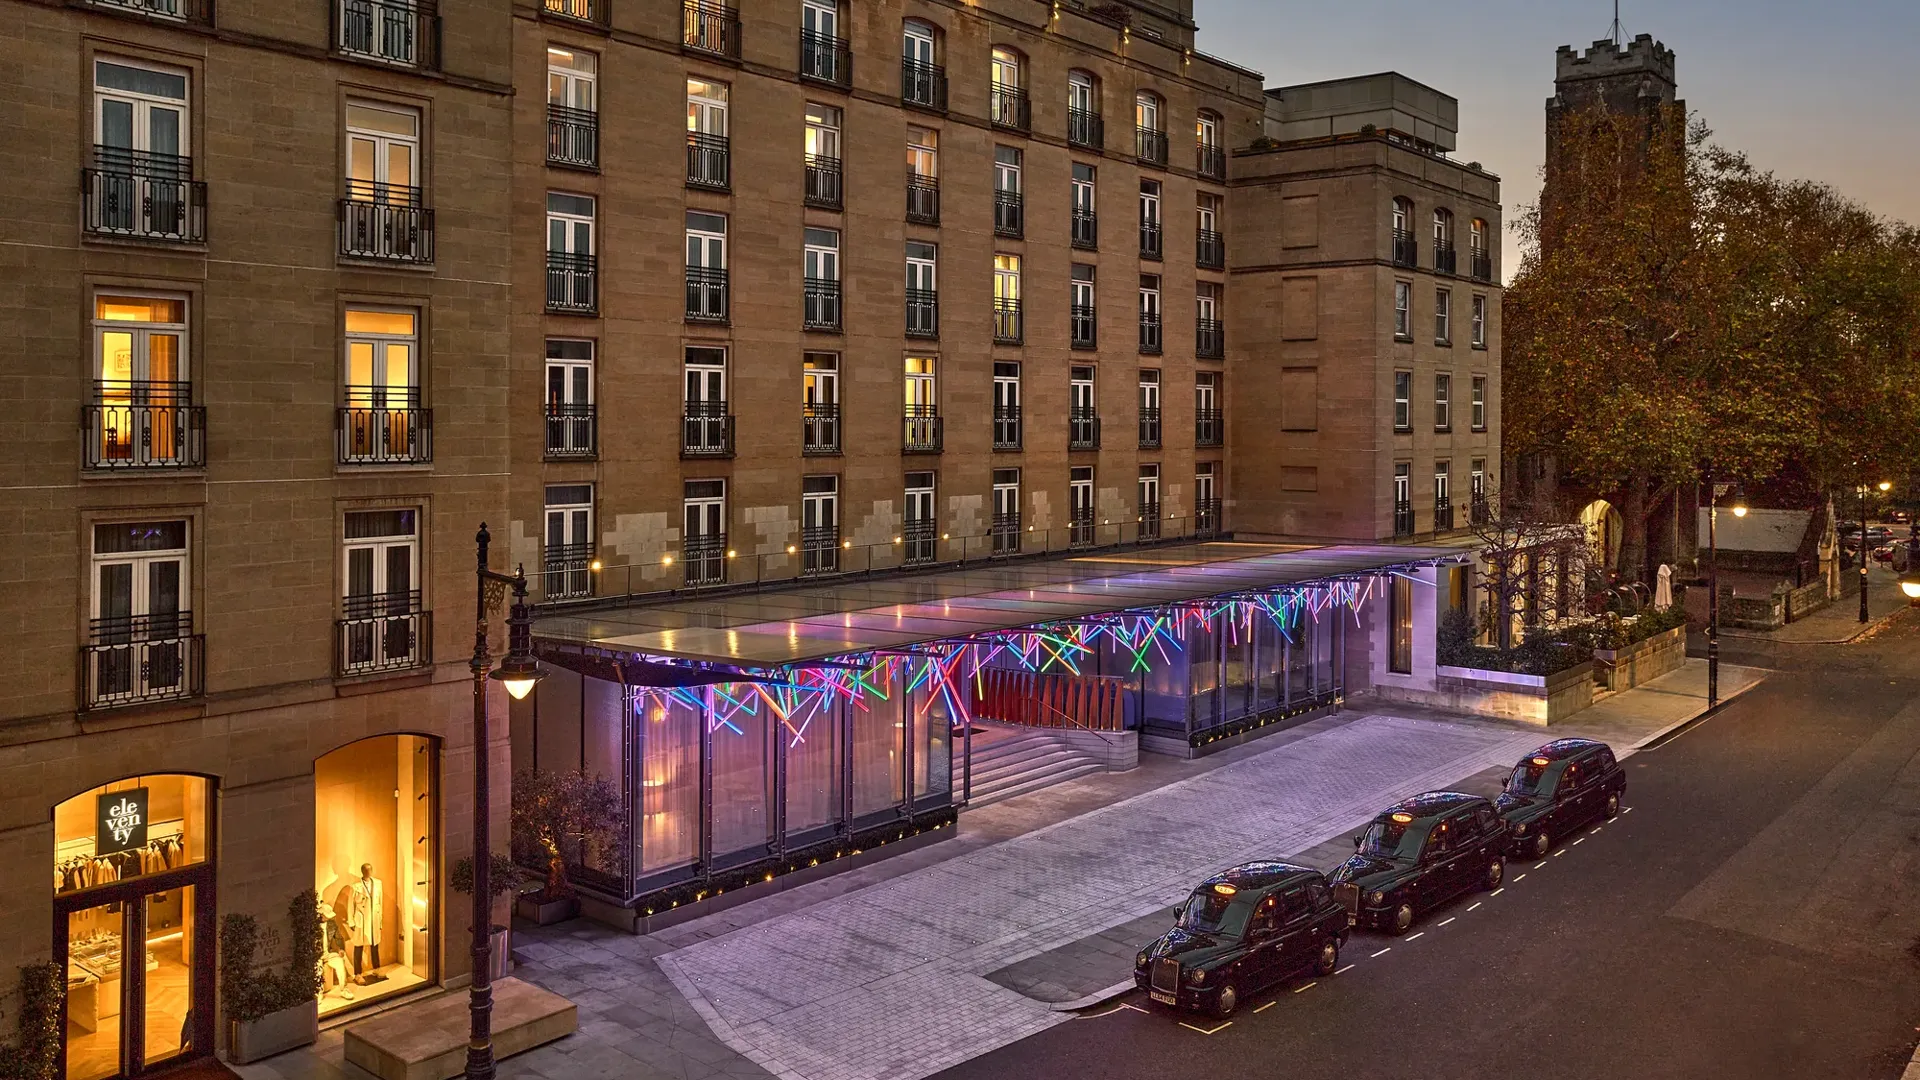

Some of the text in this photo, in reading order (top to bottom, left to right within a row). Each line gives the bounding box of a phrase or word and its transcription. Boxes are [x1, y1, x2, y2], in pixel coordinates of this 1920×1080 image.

[109, 798, 138, 817] ele
[105, 813, 141, 831] ven
[112, 827, 135, 845] ty
